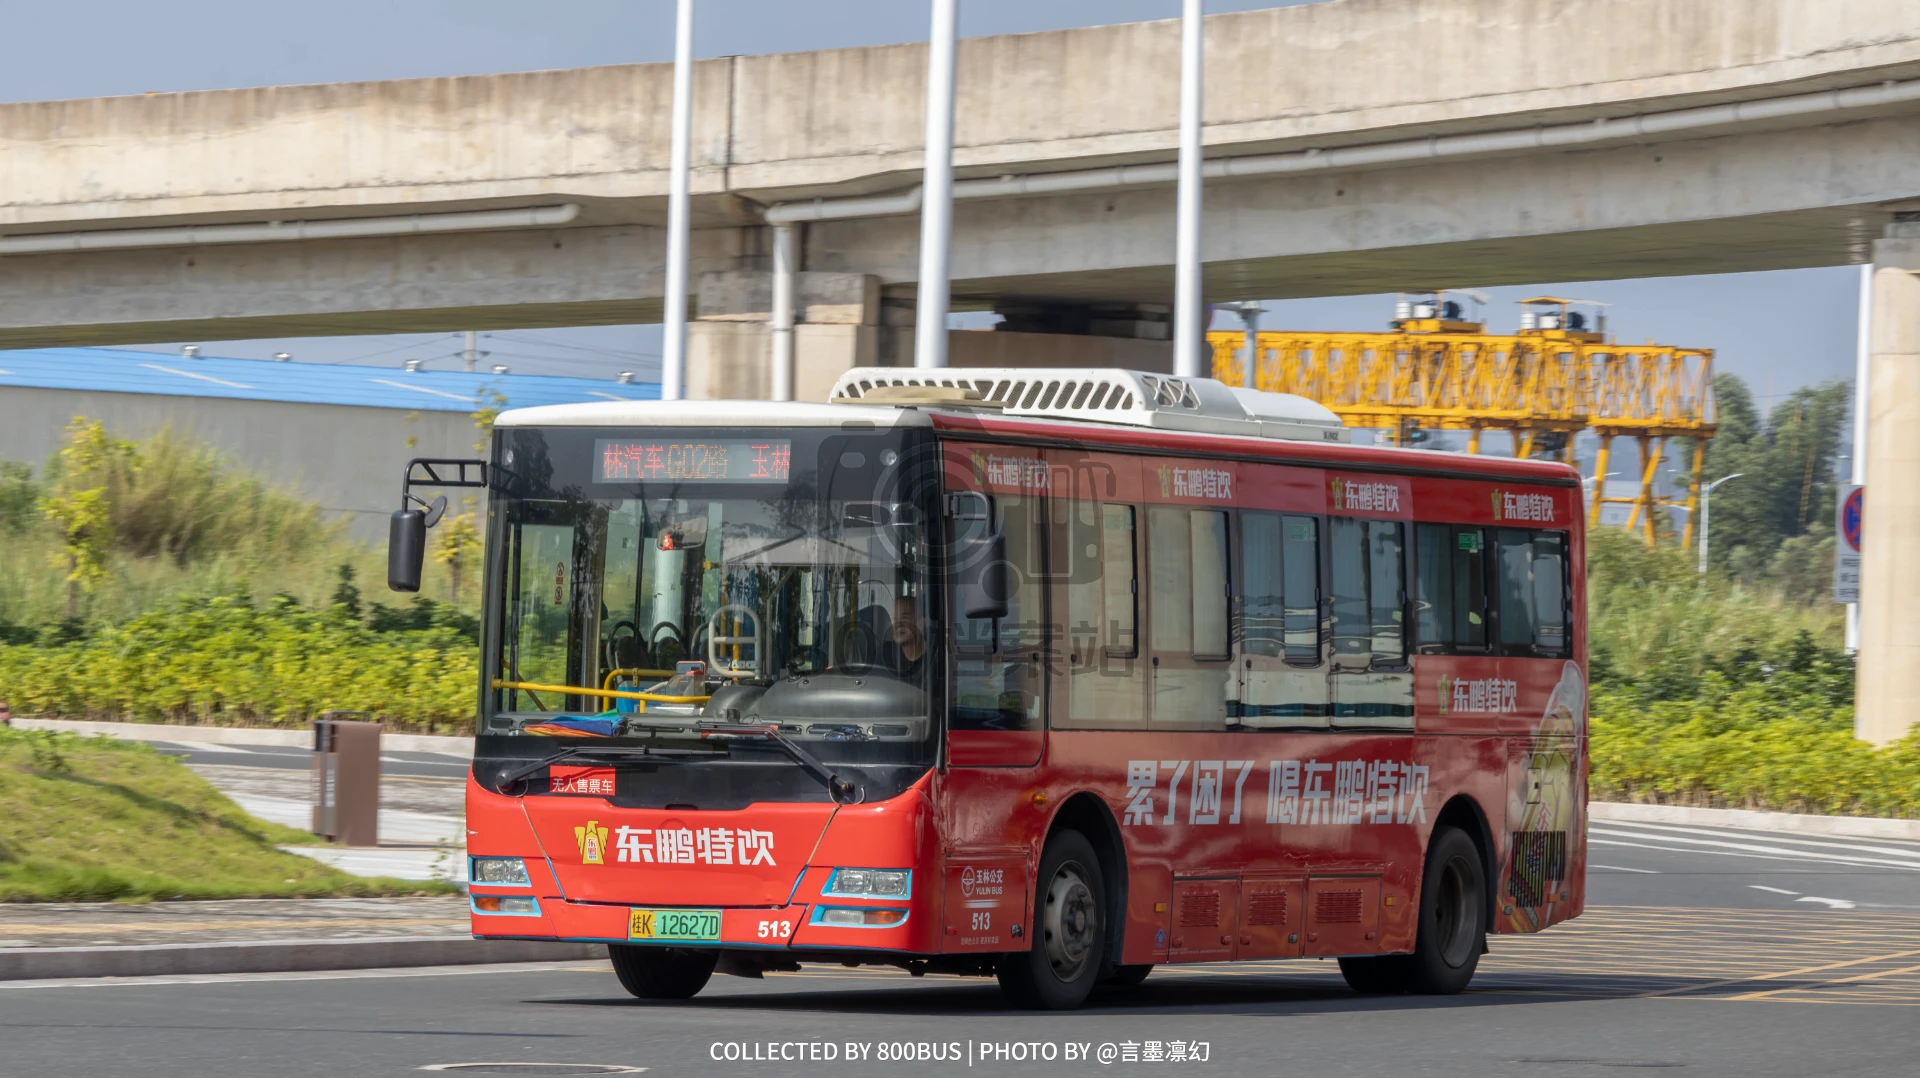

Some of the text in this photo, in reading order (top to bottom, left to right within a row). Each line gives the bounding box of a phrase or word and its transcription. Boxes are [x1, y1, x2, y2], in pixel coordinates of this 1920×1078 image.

[986, 453, 1050, 489] 东鹏特饮
[1172, 466, 1232, 499] 东鹏特饮
[1345, 480, 1400, 513] 东鹏特饮
[1503, 491, 1554, 522] 东鹏特饮
[1452, 677, 1517, 713] 东鹏特饮
[552, 777, 613, 795] 无人售票车
[1122, 758, 1430, 826] 累了困了 喝东鹏特饮
[615, 825, 776, 866] 东鹏特饮
[976, 869, 1003, 884] 玉林公交
[976, 886, 1003, 895] YULIN BUS
[632, 914, 719, 936] 桂K 12627D
[757, 920, 791, 939] 513
[972, 912, 991, 931] 513
